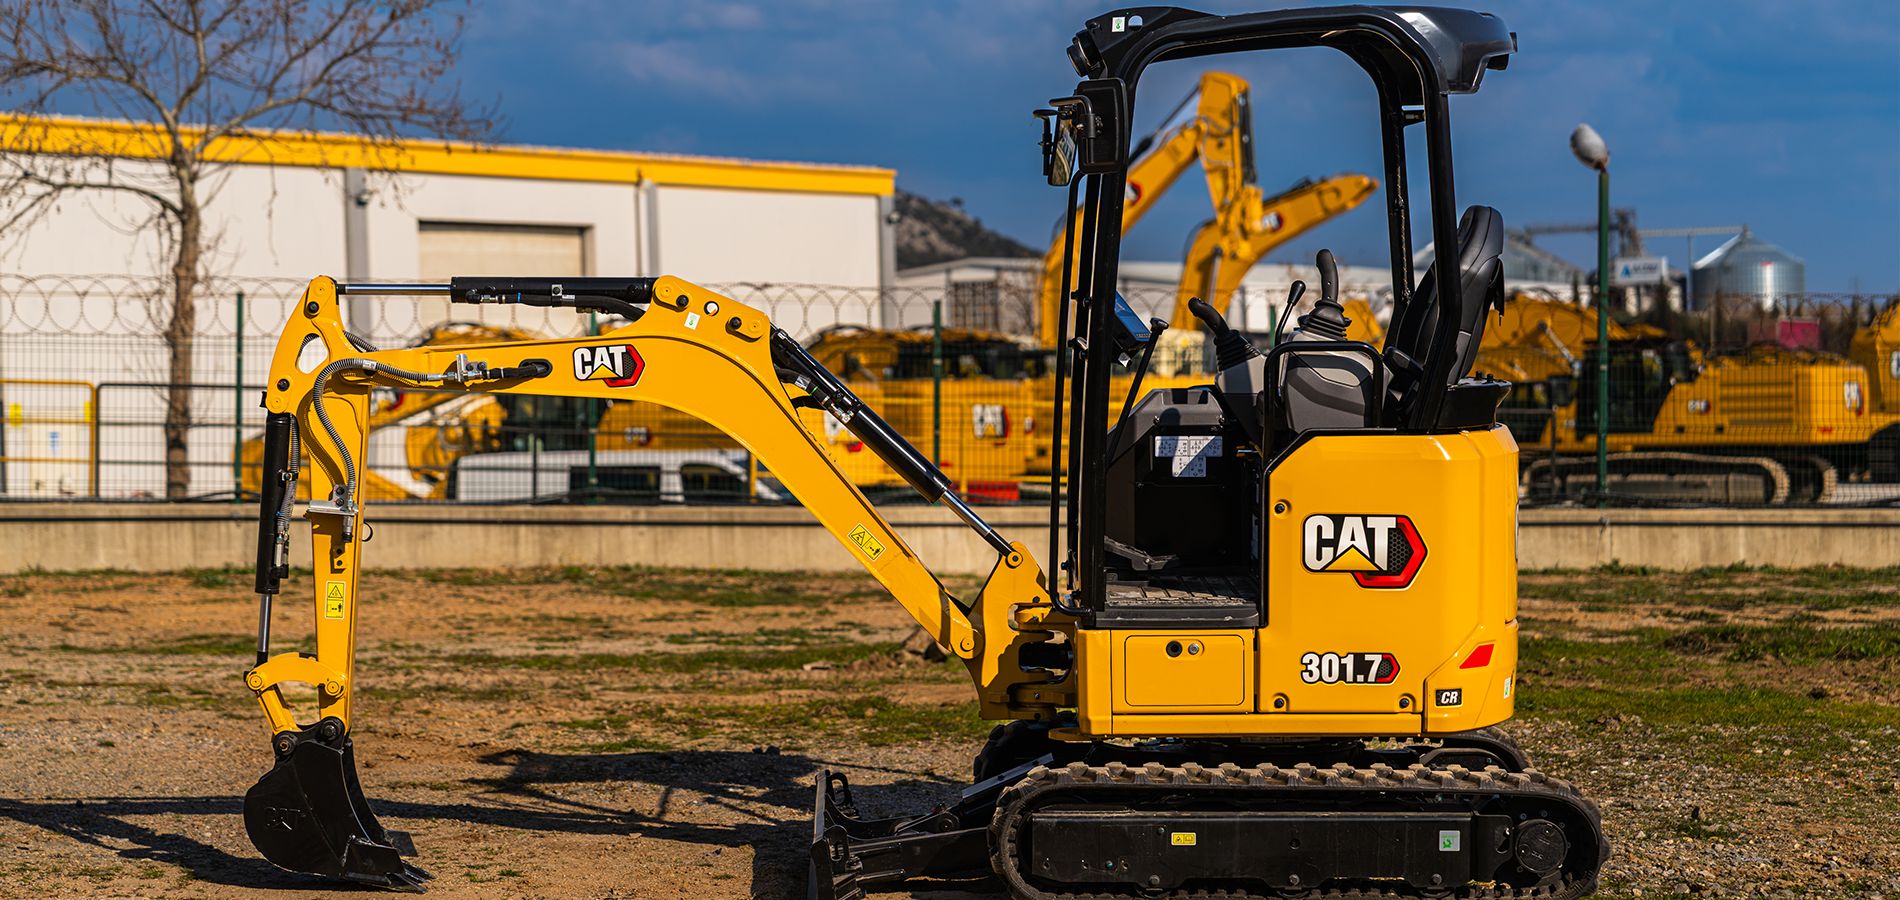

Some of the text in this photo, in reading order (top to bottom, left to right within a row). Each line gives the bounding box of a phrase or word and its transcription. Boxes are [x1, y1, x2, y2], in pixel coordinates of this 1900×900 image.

[573, 345, 626, 380] CAT
[1304, 515, 1397, 571] CAT
[1301, 653, 1383, 683] 301.7
[1440, 691, 1459, 704] CR
